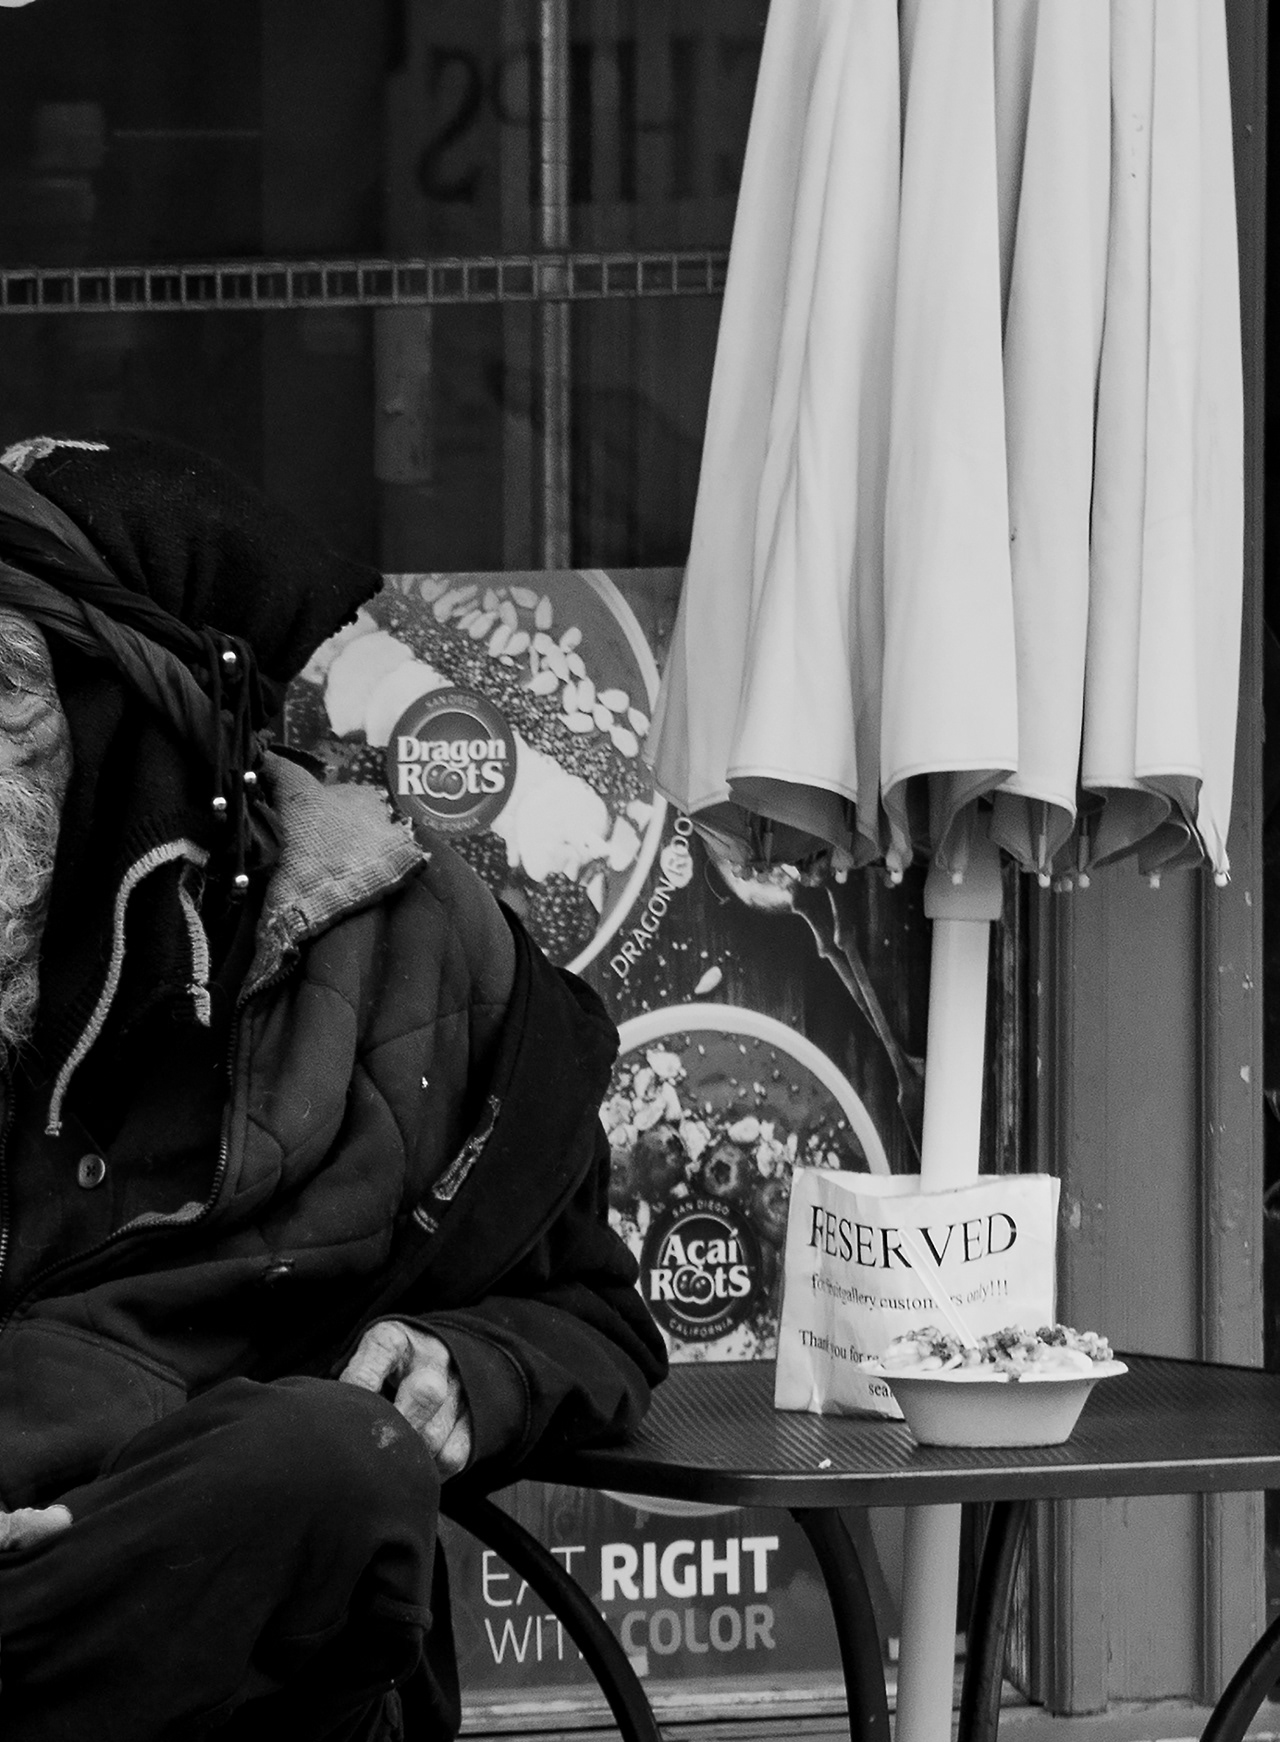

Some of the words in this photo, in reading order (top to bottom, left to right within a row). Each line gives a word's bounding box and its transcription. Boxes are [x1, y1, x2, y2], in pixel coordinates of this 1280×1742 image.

[397, 736, 506, 768] Dragon
[609, 876, 676, 979] DRAGON
[671, 1202, 694, 1218] SAN
[695, 1199, 731, 1216] DIEGO
[880, 1293, 963, 1311] customs
[668, 1316, 734, 1338] CALIFORNIA
[868, 1382, 893, 1398] sea
[481, 1545, 586, 1607] ET
[600, 1535, 780, 1602] RIGHT
[484, 1612, 607, 1664] WIT
[621, 1603, 777, 1656] COLOR
